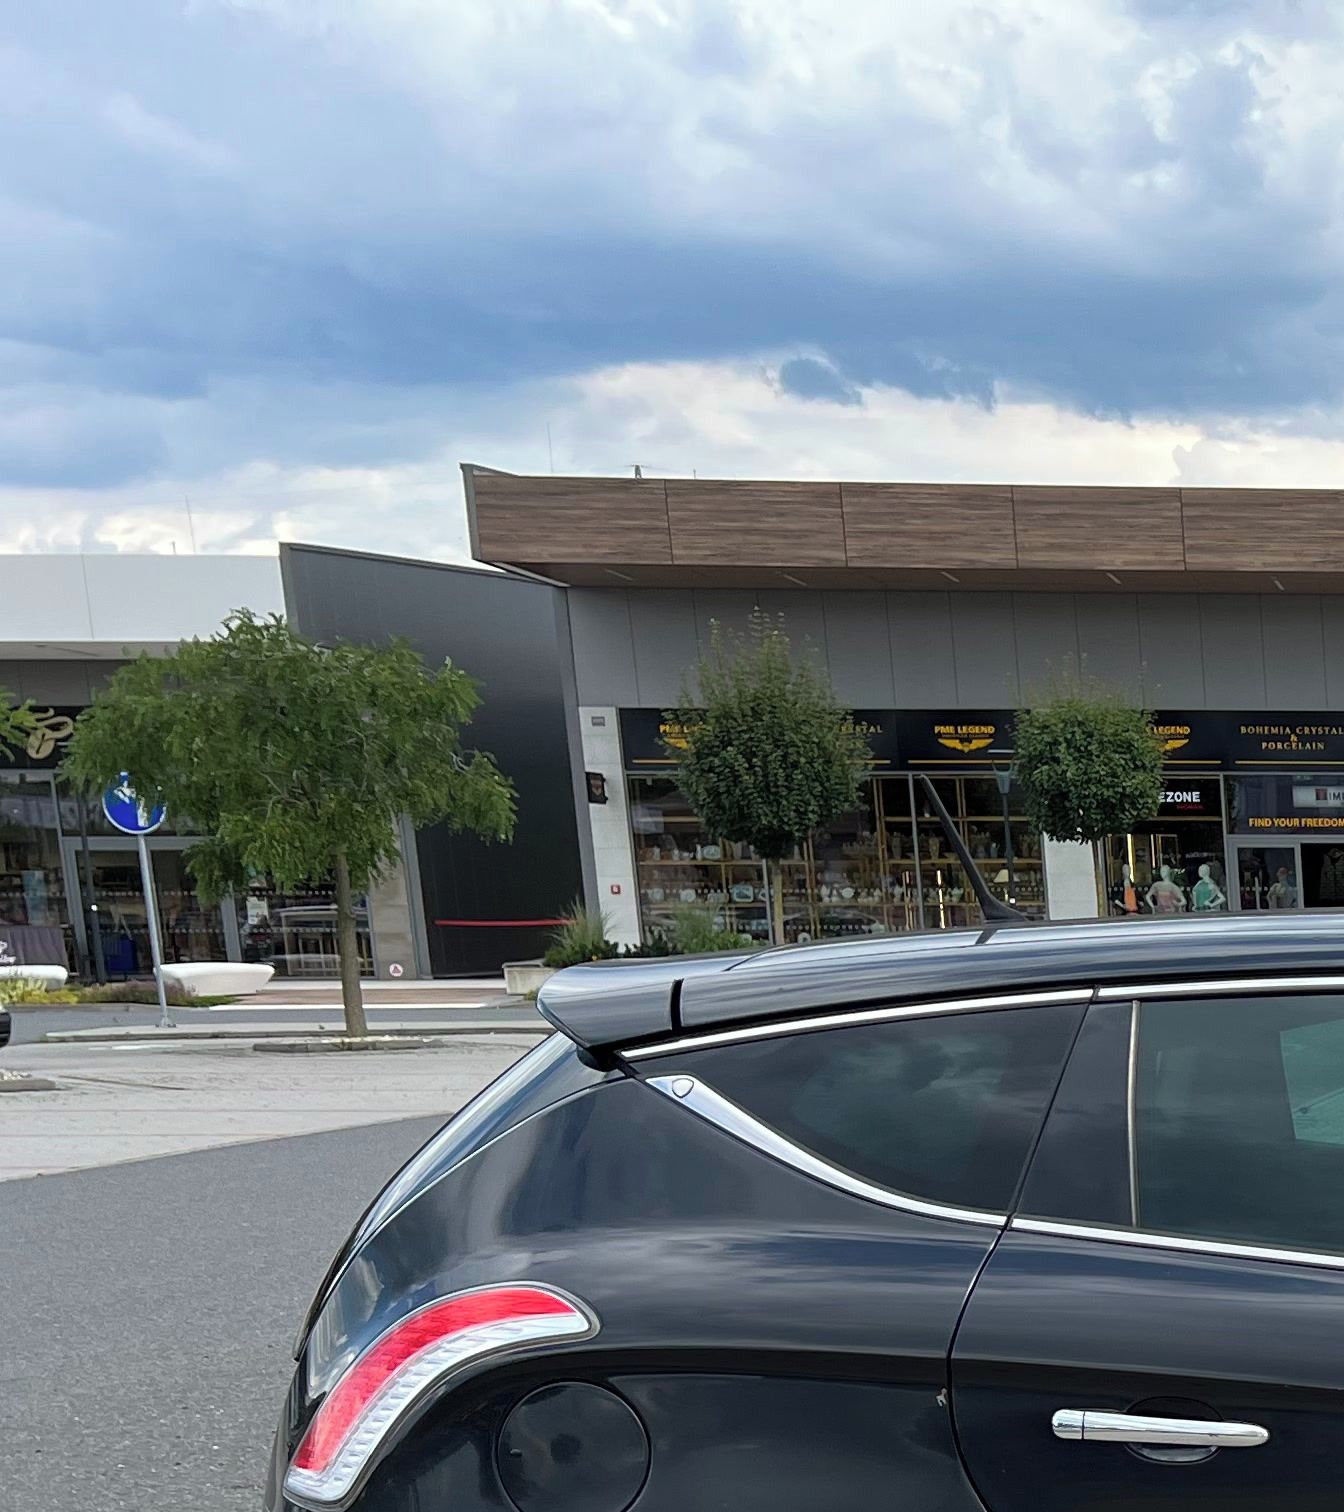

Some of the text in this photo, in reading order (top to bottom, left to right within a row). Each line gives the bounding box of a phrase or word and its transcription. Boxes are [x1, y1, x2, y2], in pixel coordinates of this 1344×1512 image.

[934, 725, 996, 734] PME LEGEND
[1240, 726, 1344, 735] BOHEMIA CRYSTAL
[1261, 742, 1325, 750] PORCELAIN
[1248, 818, 1272, 828] FIND
[1273, 818, 1300, 828] YOUR
